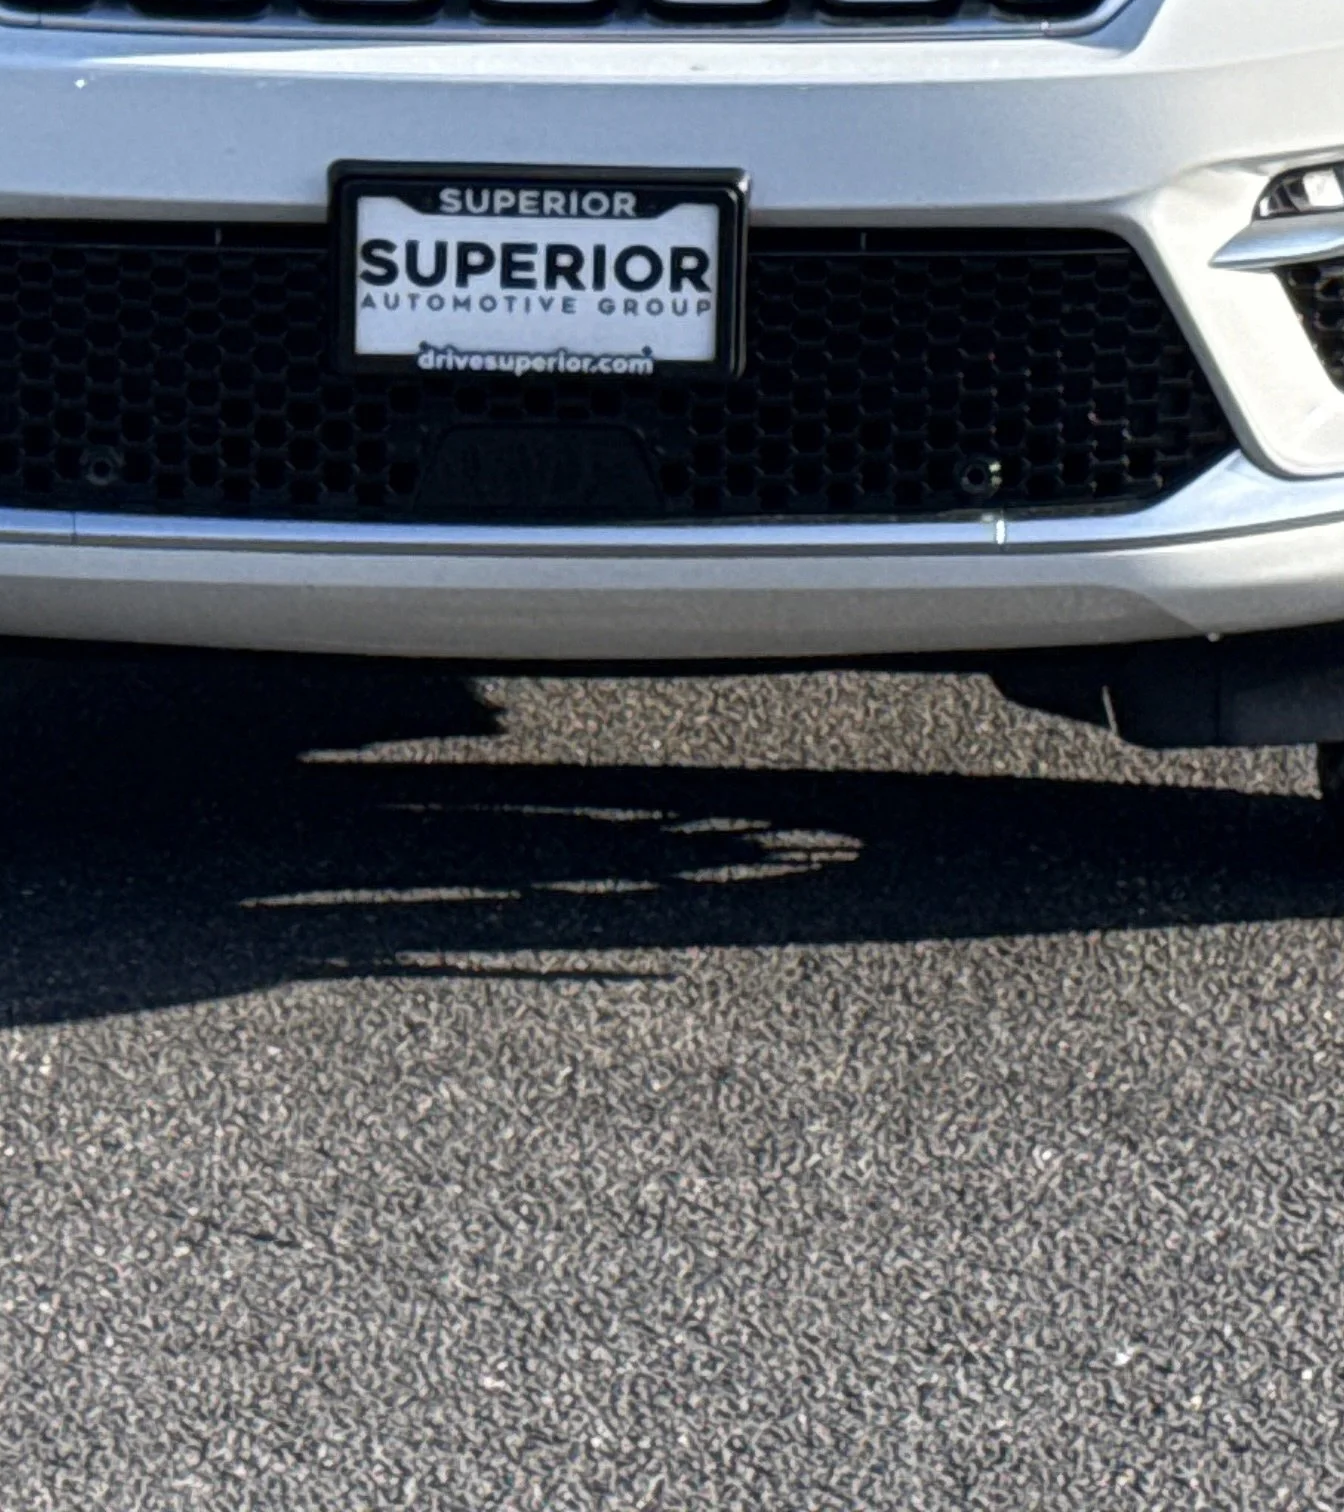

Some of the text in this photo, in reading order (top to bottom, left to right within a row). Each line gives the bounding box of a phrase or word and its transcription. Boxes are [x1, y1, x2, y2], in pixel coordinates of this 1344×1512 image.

[438, 188, 638, 218] SUPERIOR
[359, 238, 711, 293] SUPERIOR
[360, 292, 712, 317] AUTOMOTIVE GROUP
[416, 347, 654, 377] drivesuperior.com
